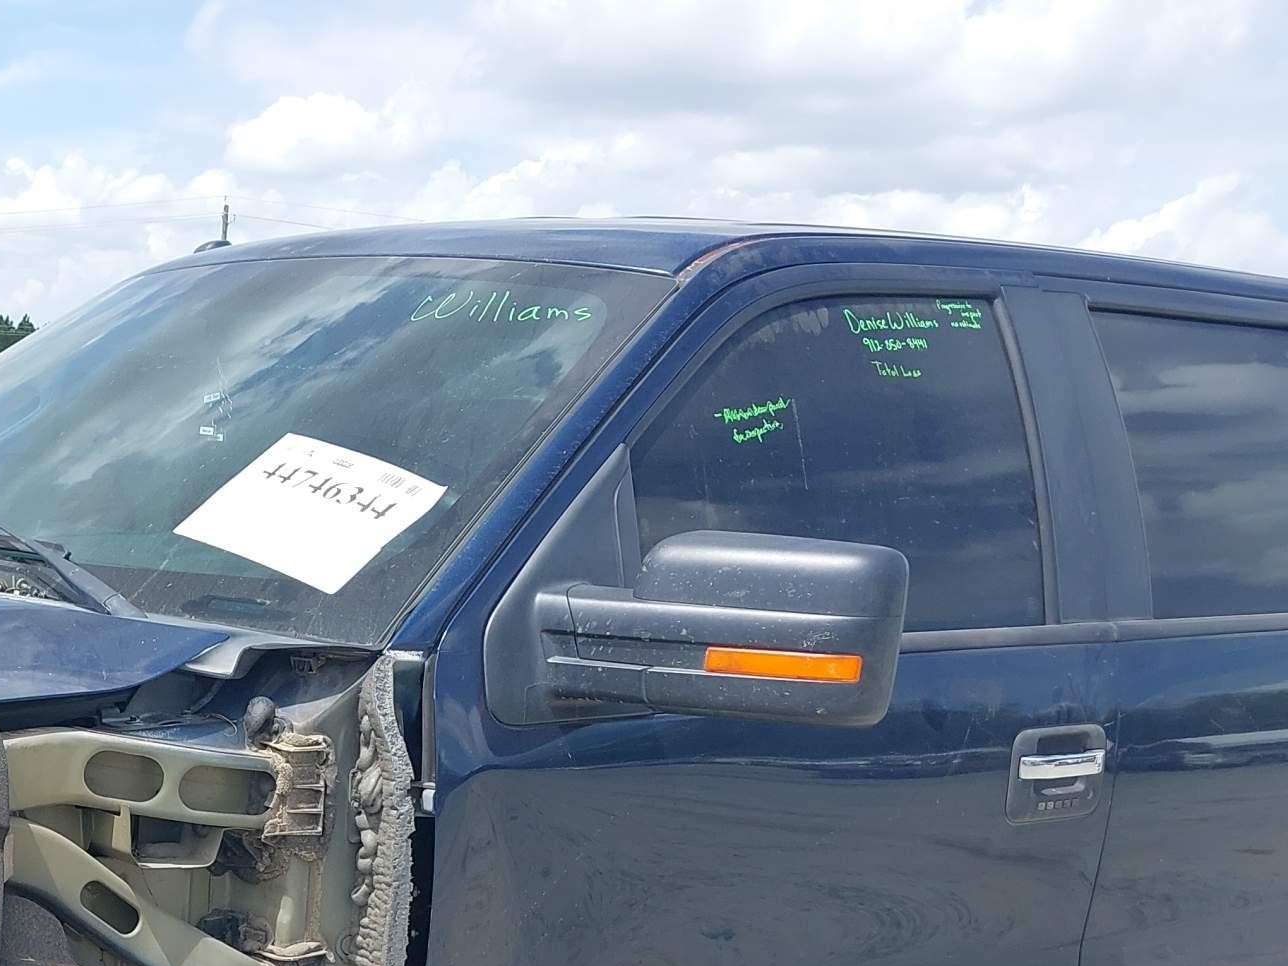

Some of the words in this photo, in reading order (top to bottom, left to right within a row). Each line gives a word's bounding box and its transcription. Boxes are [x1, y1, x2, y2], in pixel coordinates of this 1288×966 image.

[411, 290, 592, 321] Williams
[843, 309, 888, 334] Denise
[886, 311, 939, 330] Williams
